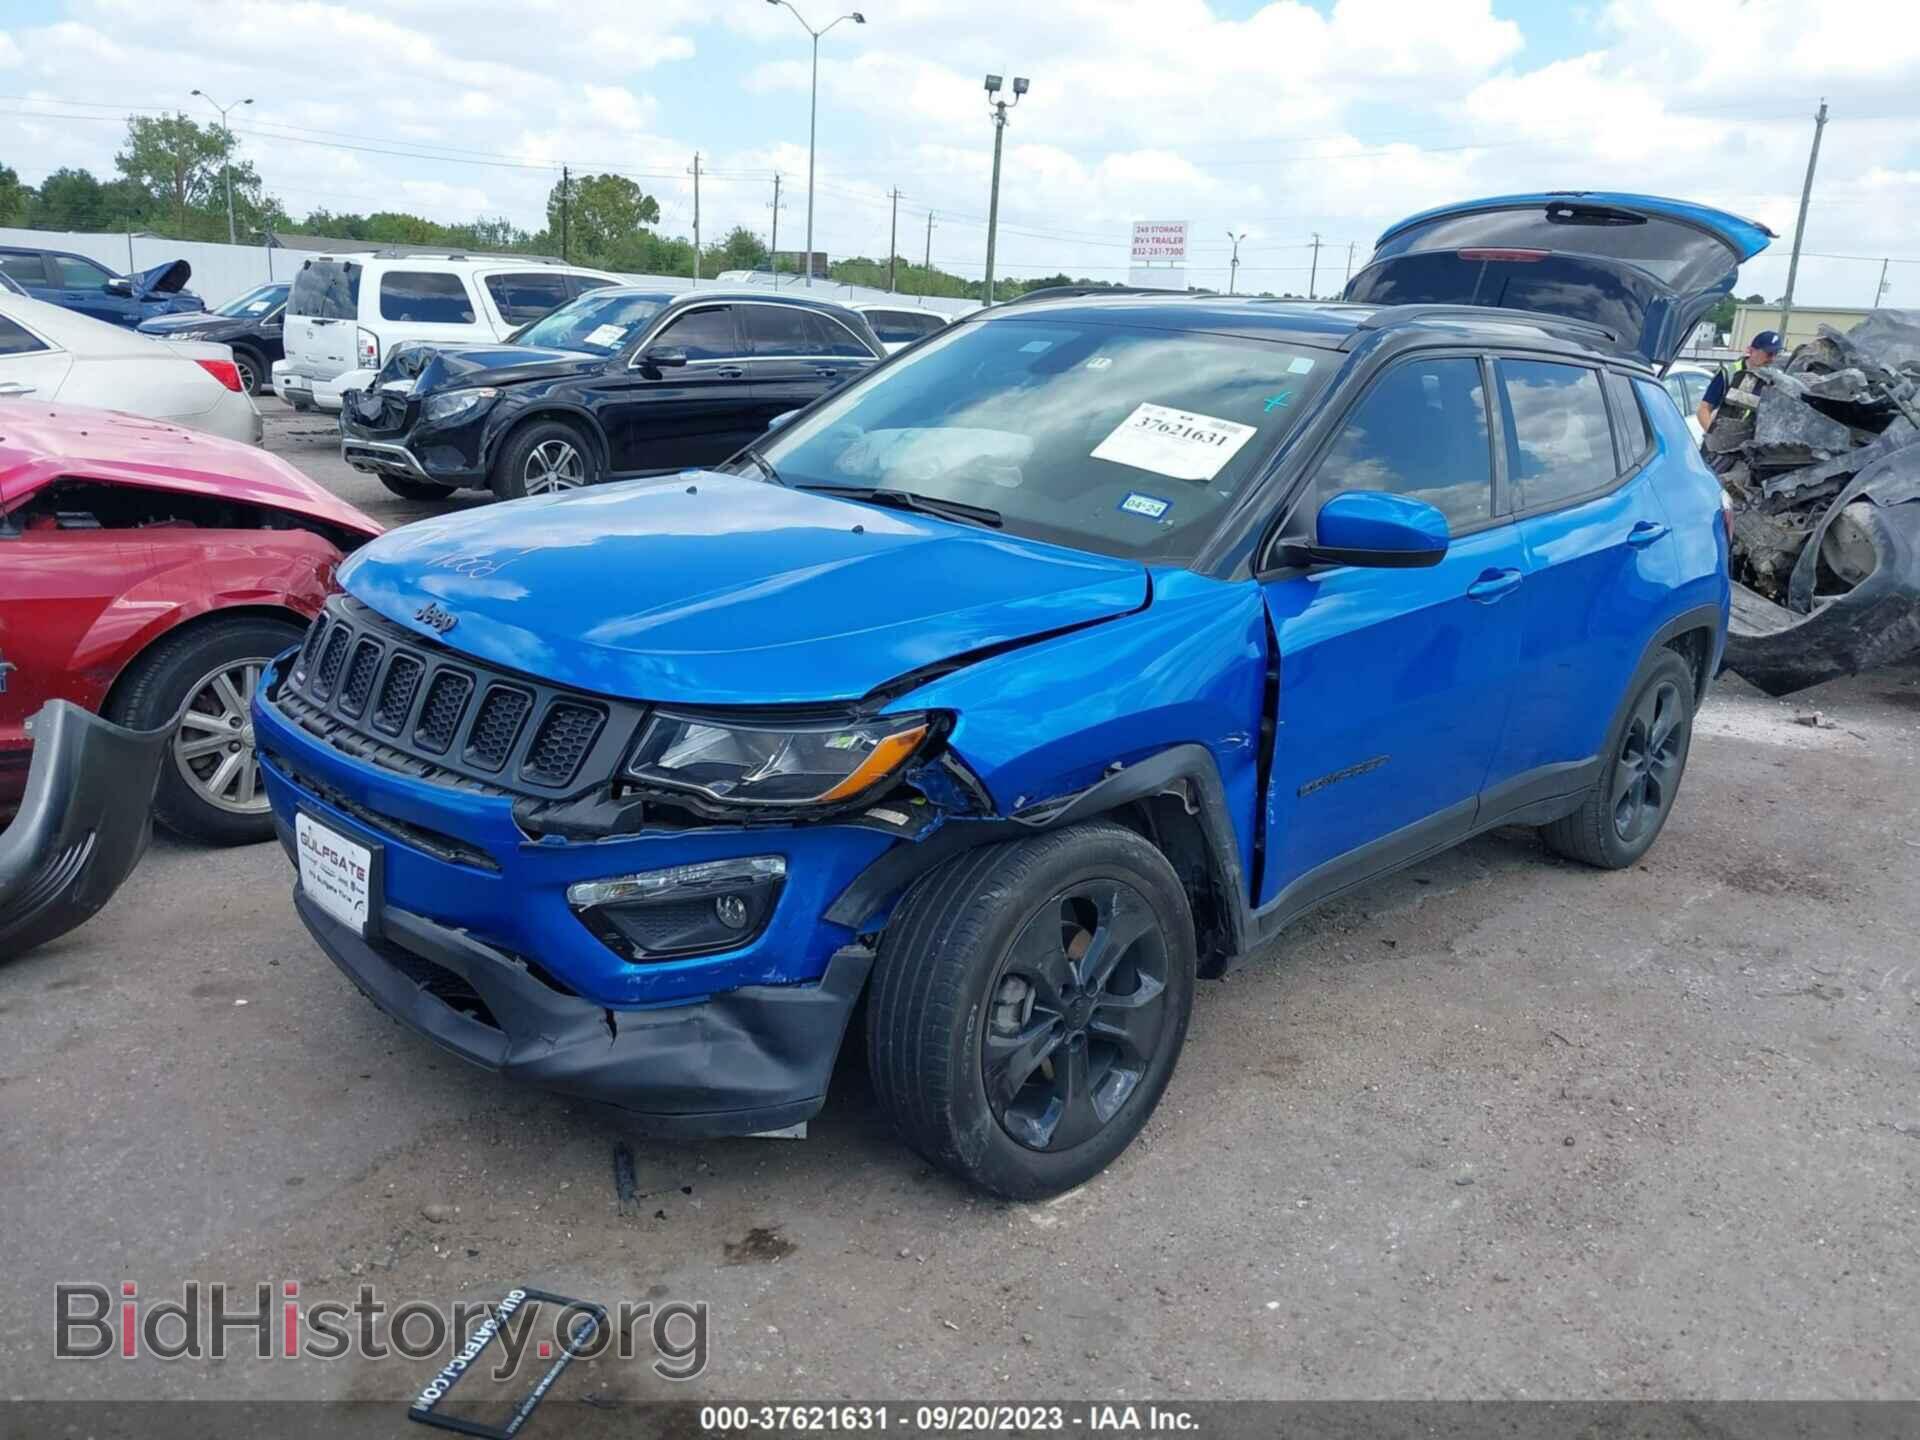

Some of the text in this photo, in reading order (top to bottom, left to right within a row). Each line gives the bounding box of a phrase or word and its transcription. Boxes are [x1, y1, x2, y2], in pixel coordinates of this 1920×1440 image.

[1151, 225, 1183, 233] STORAGE
[1151, 237, 1184, 245] TRAILER
[1134, 416, 1229, 447] 37621631
[414, 602, 459, 635] Jeep
[300, 832, 366, 882] GULFGATE
